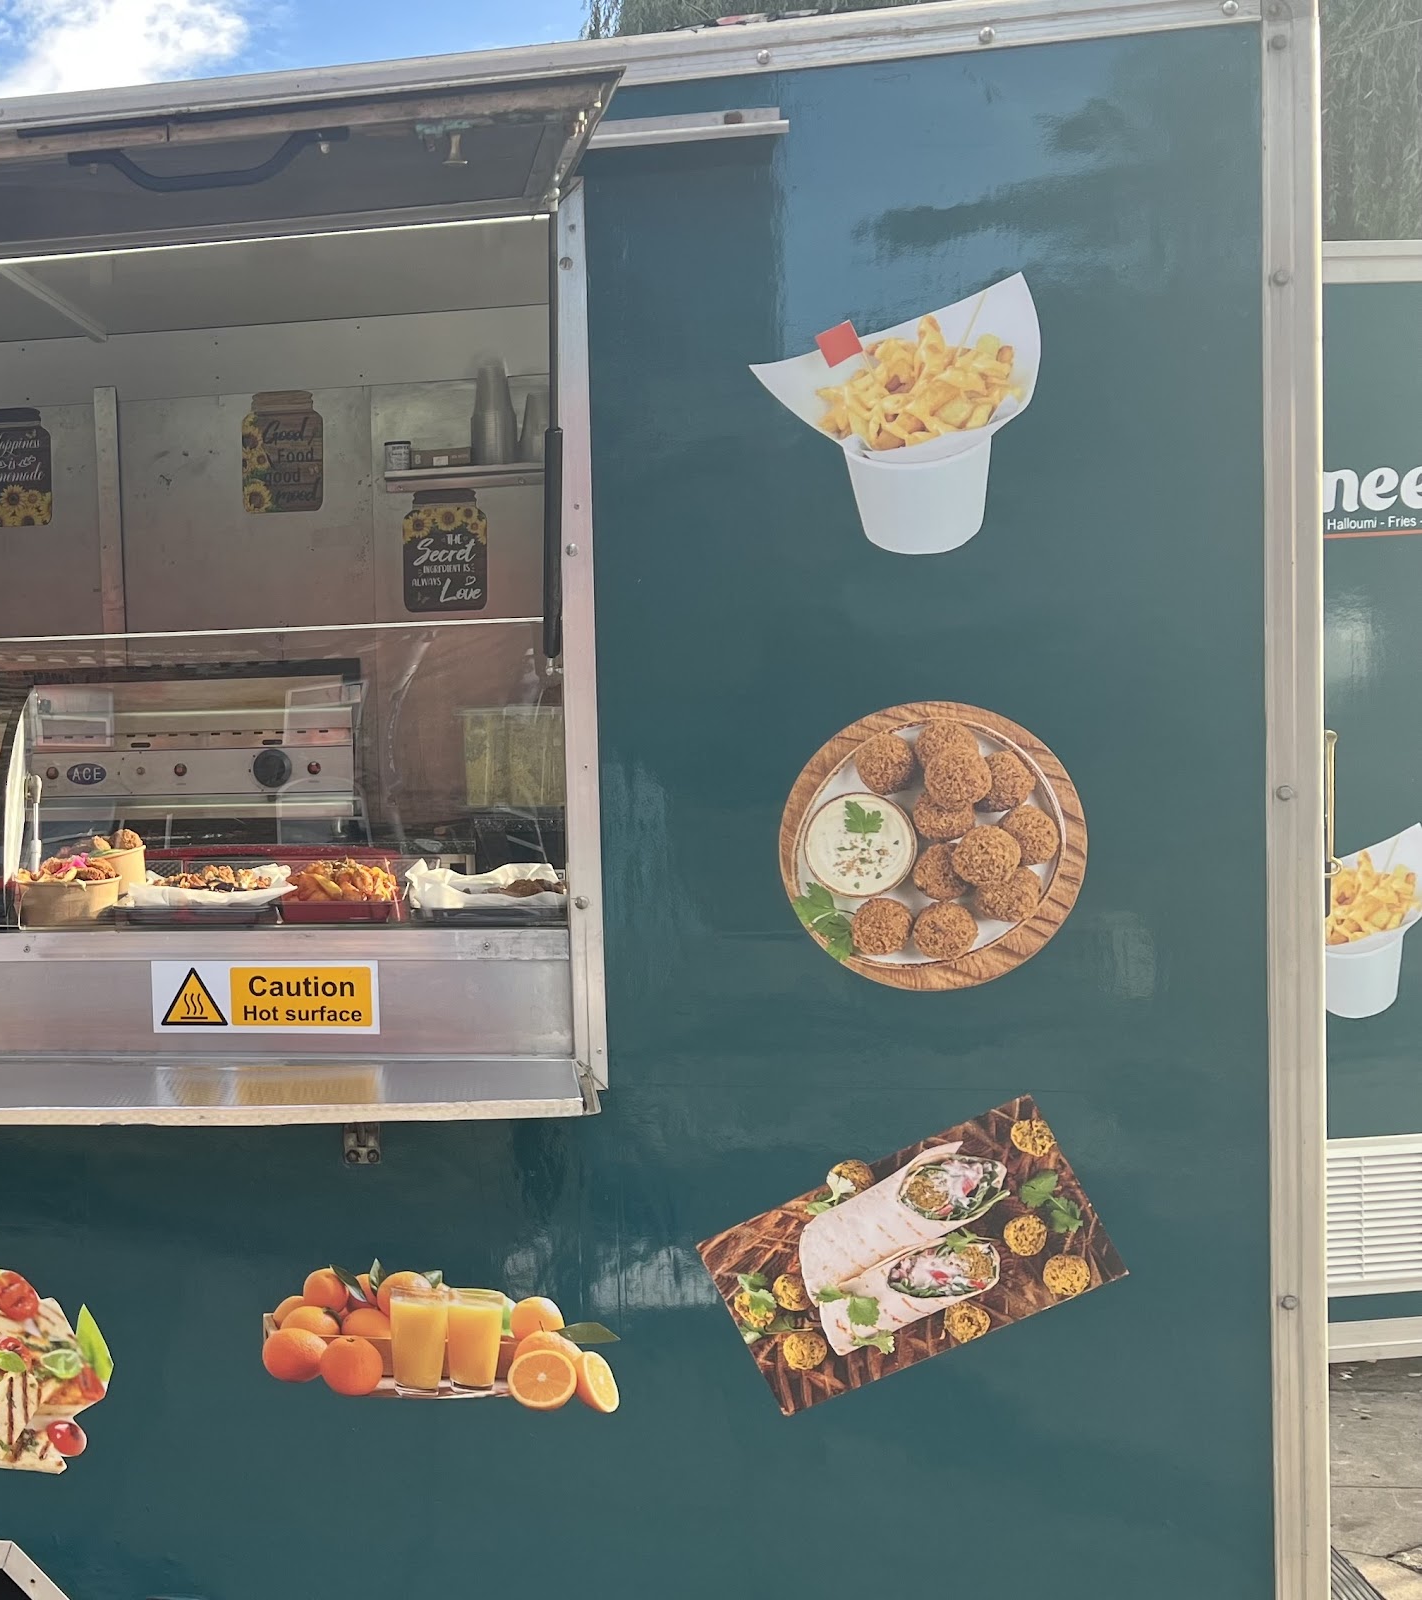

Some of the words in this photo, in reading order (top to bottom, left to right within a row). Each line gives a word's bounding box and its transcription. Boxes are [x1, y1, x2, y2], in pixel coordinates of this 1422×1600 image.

[263, 417, 309, 445] Good
[8, 458, 16, 470] is
[278, 448, 314, 464] Food
[264, 467, 301, 486] good
[1327, 517, 1377, 530] Halloumi
[1388, 515, 1417, 528] Fries
[446, 534, 463, 545] THE
[412, 538, 477, 566] Secret
[463, 563, 471, 573] IS
[412, 577, 442, 587] ALWAYS
[440, 578, 483, 603] Love
[72, 766, 102, 781] ACE
[248, 975, 355, 997] Caution
[243, 1004, 279, 1021] Hot
[285, 1004, 362, 1021] surface
